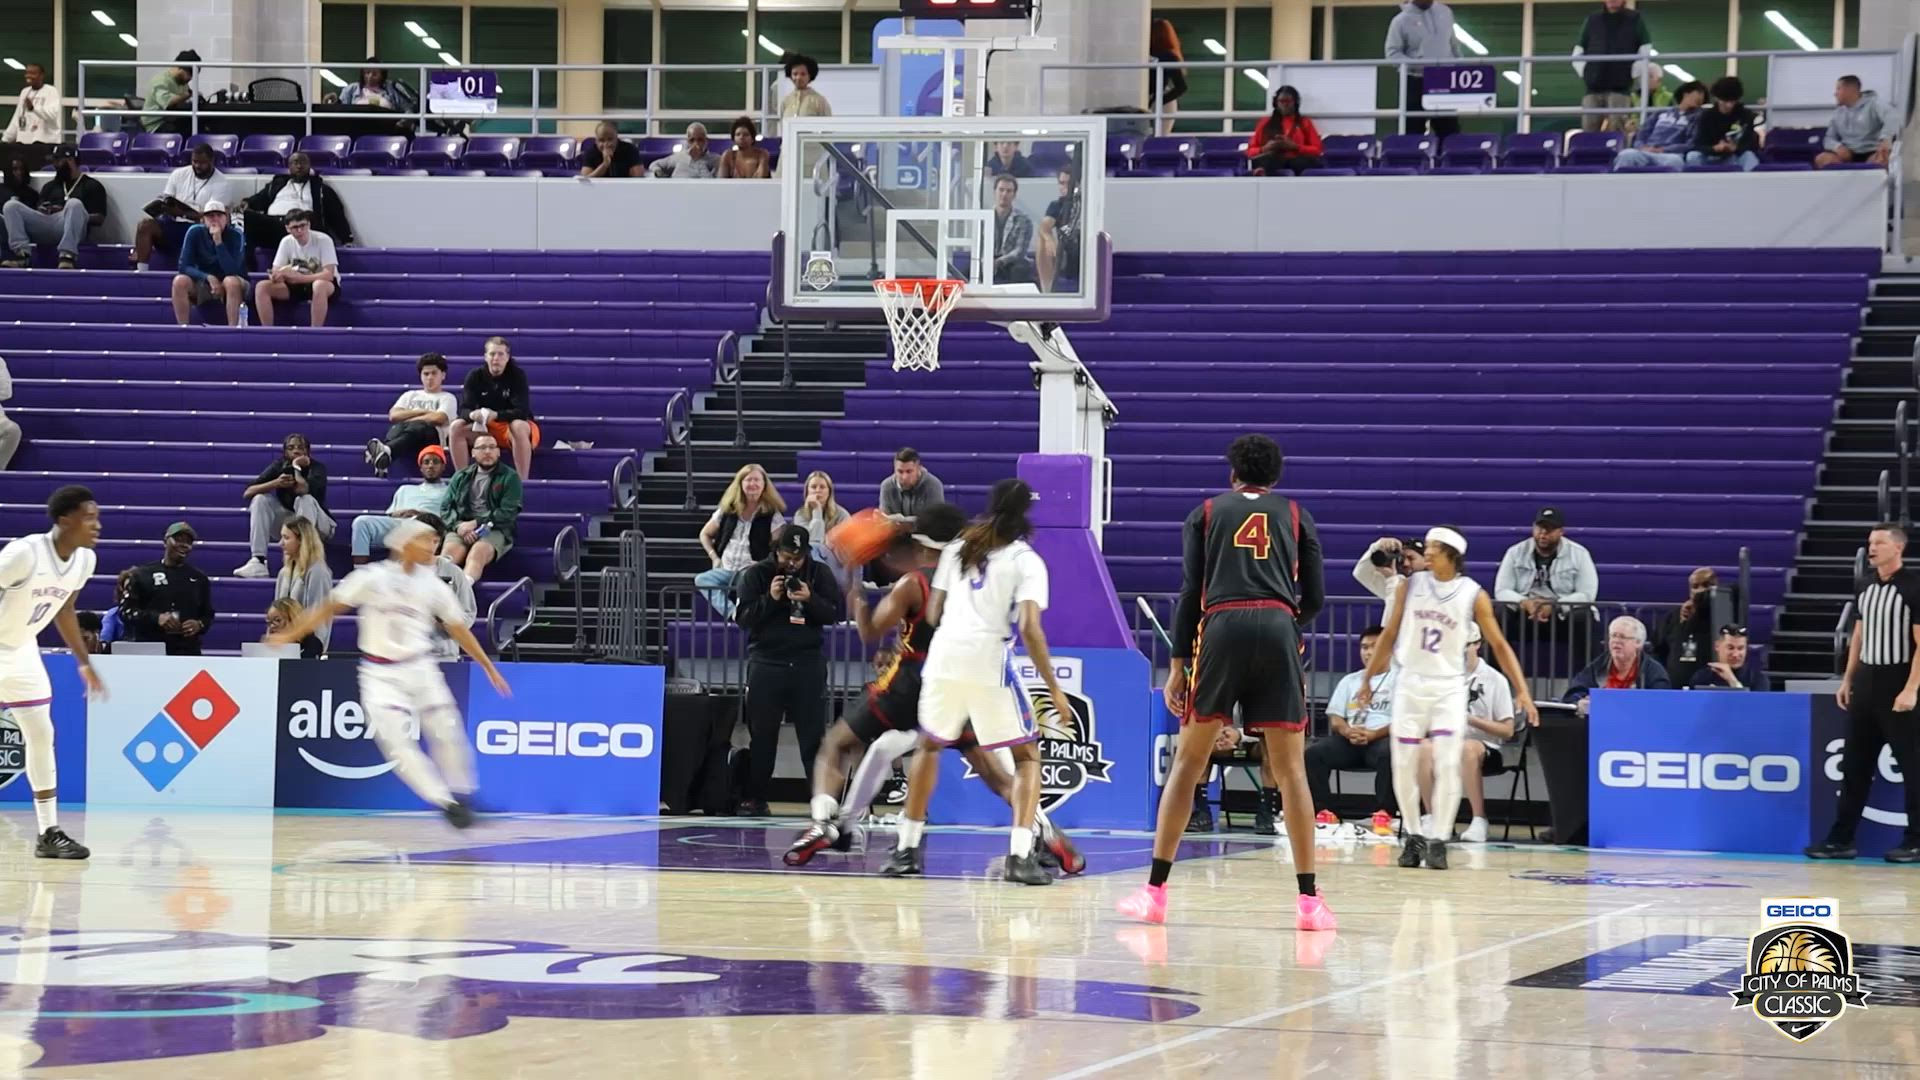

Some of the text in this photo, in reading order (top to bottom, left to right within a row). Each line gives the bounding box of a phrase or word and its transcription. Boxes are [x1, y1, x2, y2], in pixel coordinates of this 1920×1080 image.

[457, 76, 484, 94] 101
[1450, 70, 1483, 89] 102
[1234, 513, 1270, 559] 4
[1421, 626, 1443, 654] 12
[476, 720, 654, 759] GEICO
[1050, 742, 1094, 764] PALMS
[1598, 750, 1801, 793] GEICO
